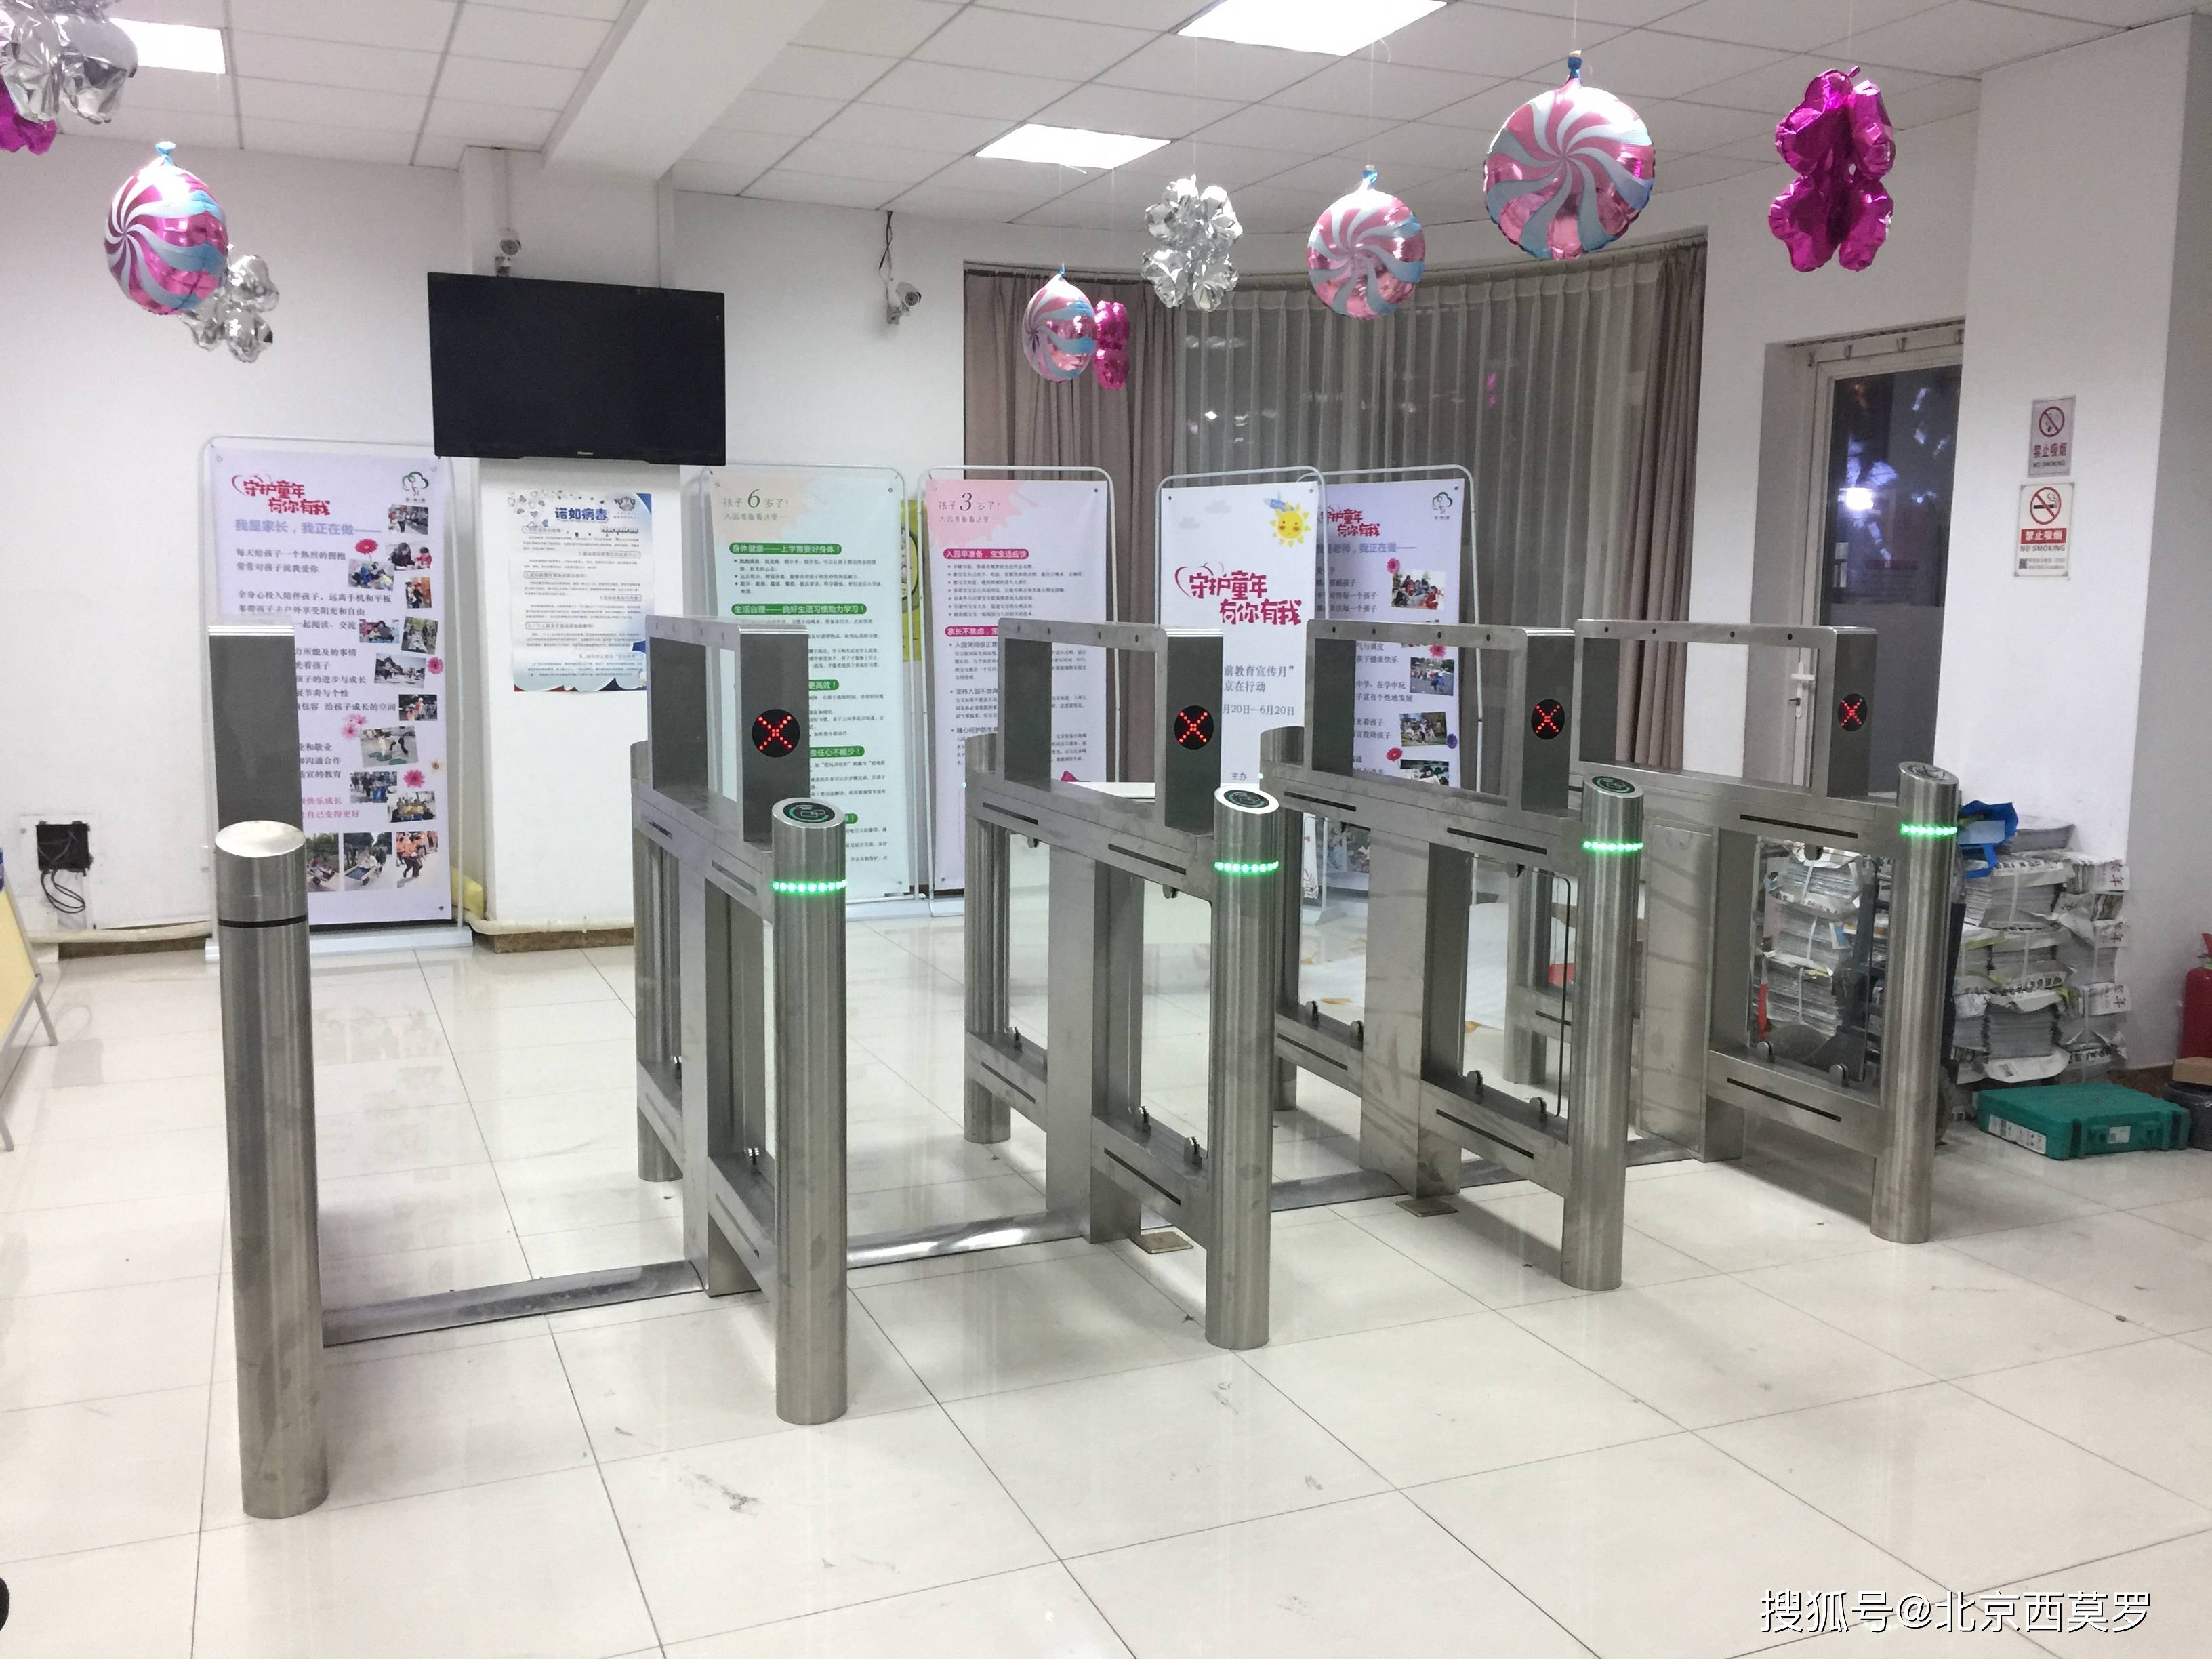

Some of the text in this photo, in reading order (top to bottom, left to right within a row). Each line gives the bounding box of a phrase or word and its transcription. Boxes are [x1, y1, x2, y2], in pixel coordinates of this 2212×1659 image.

[2034, 443, 2067, 458] 禁止吸烟
[243, 480, 304, 499] 守护童年
[268, 497, 330, 515] 有你有我
[554, 507, 609, 522] 诺如病毒
[1337, 522, 1380, 537] 有你有我
[2025, 530, 2063, 541] 禁止吸烟
[1189, 570, 1267, 600] 守护童年
[1220, 599, 1302, 625] 有你有我
[1224, 680, 1266, 693] 京在行动
[1231, 771, 1247, 781] 主办
